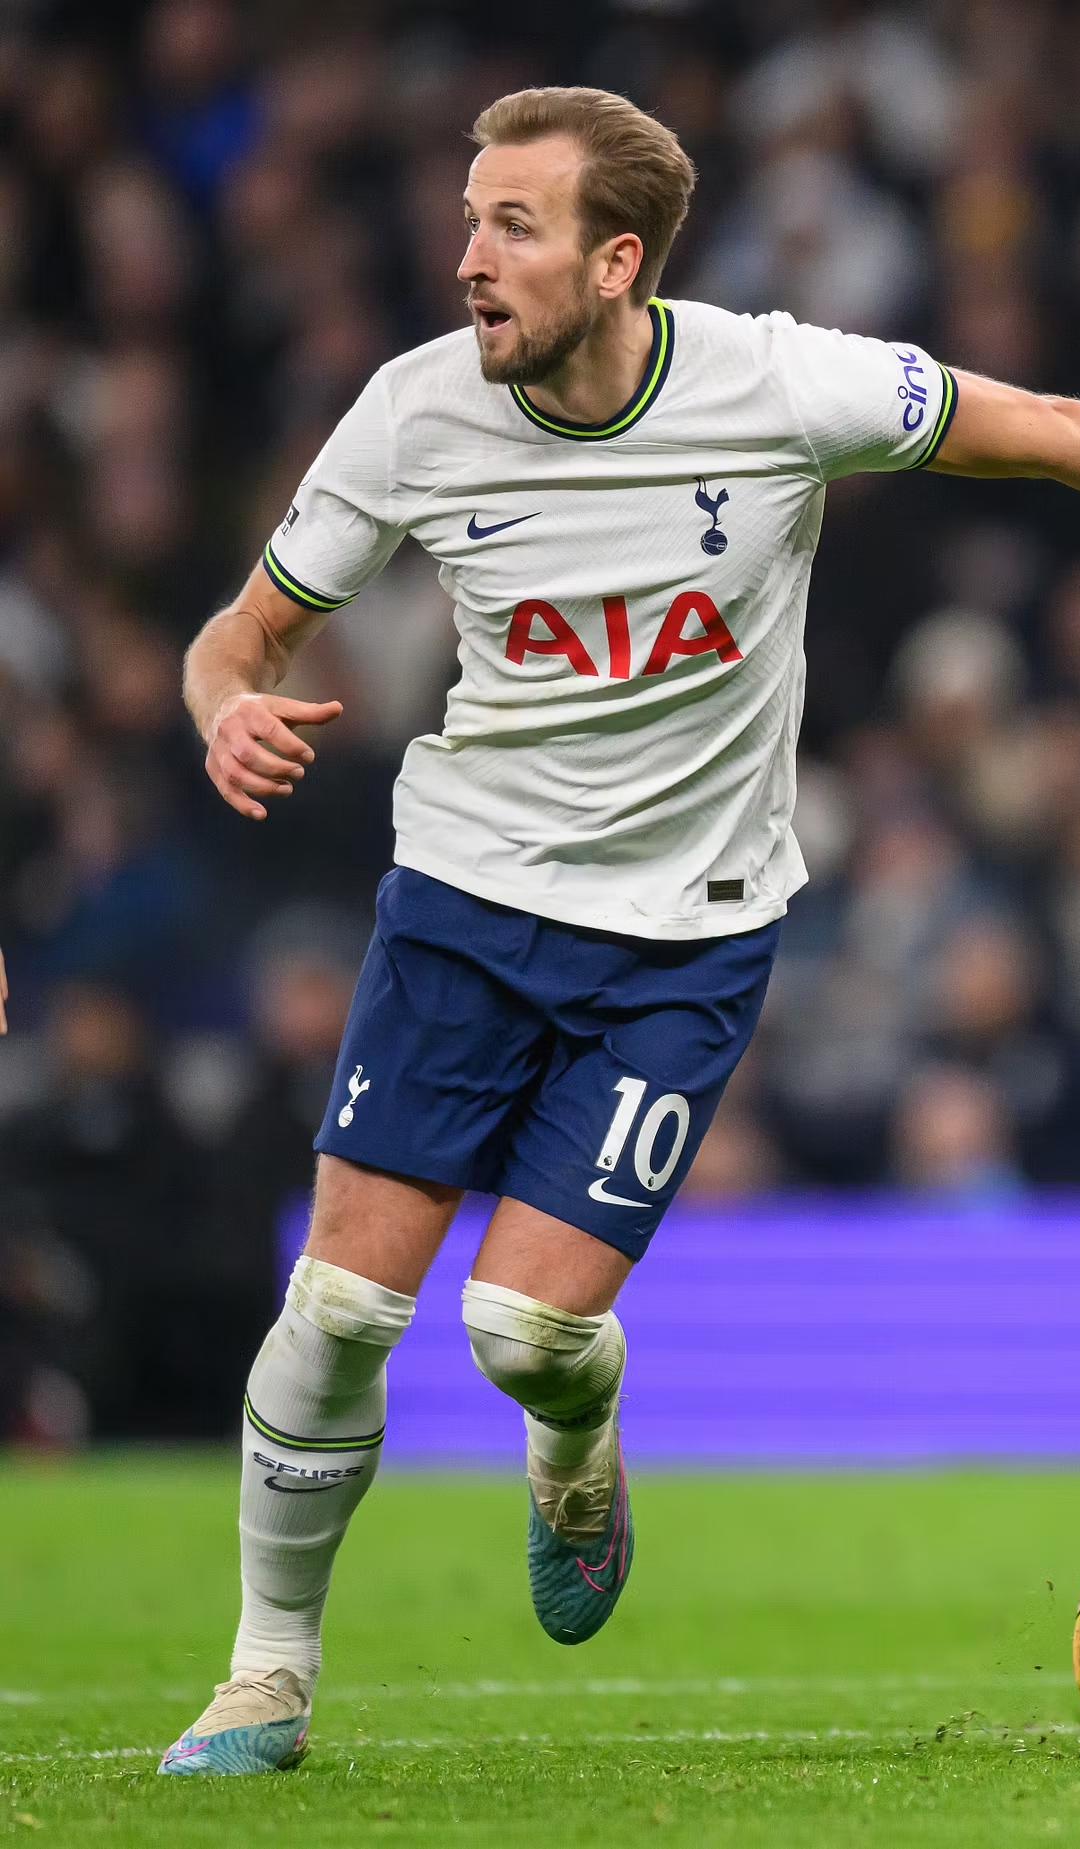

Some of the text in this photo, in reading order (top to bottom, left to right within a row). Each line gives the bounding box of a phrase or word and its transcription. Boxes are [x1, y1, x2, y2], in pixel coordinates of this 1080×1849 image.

[504, 591, 744, 680] AIA
[595, 1076, 690, 1192] 10
[253, 1451, 365, 1480] SPURS
